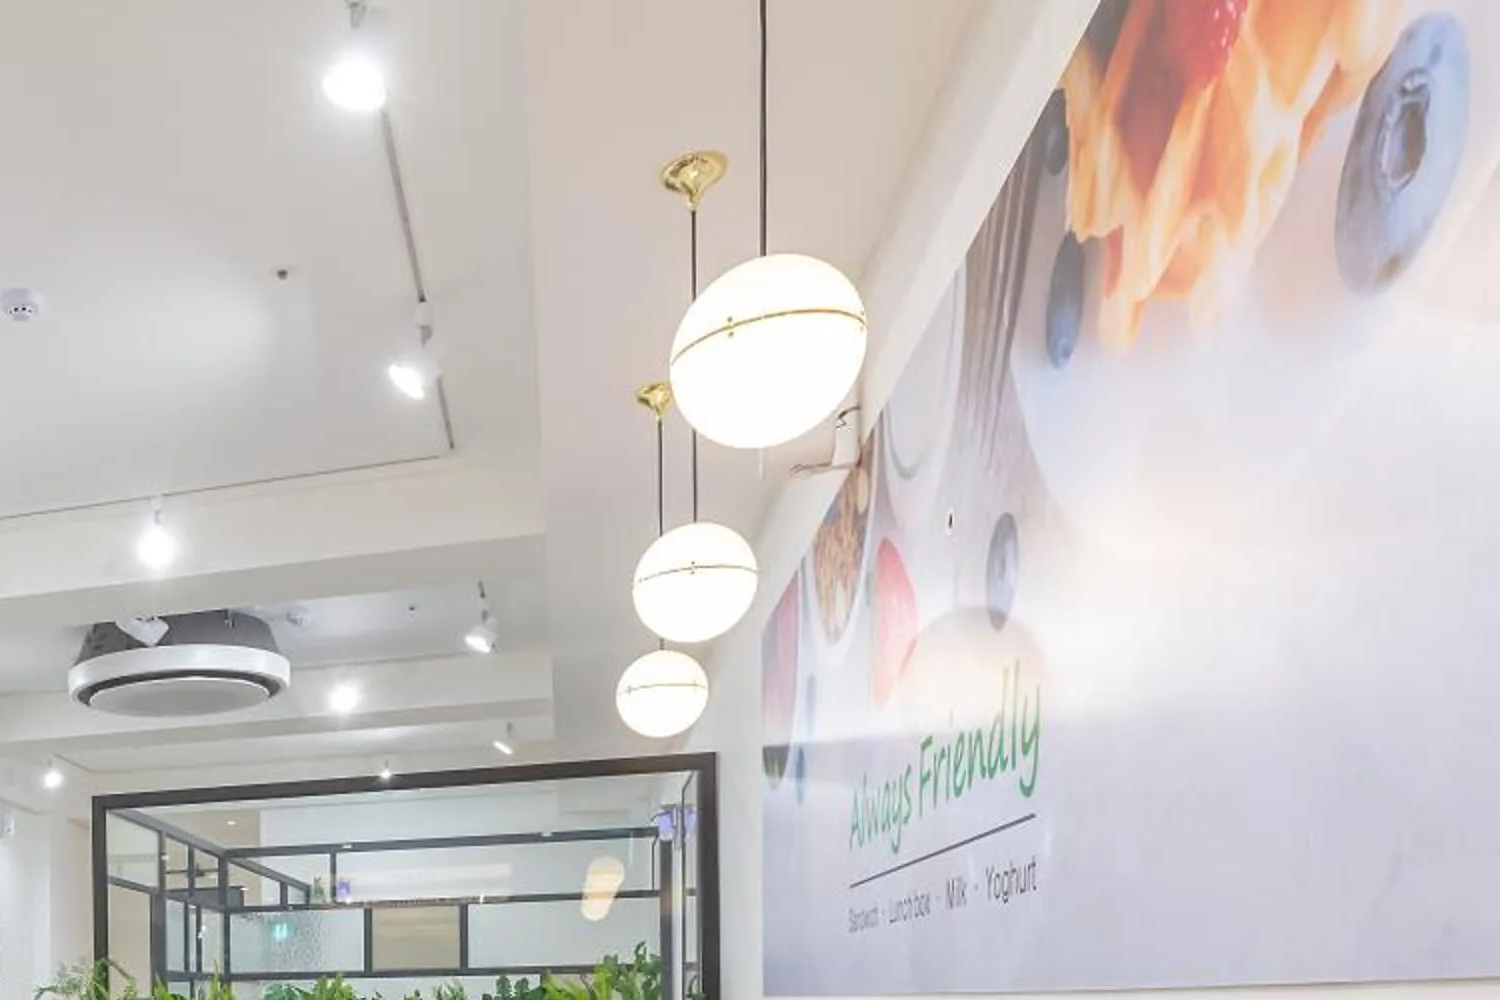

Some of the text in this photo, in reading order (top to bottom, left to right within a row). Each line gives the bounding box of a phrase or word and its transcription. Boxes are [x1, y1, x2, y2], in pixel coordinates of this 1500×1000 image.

[850, 659, 1041, 855] Always Friendly
[945, 877, 968, 910] Milk
[984, 856, 1037, 904] Yoghurt
